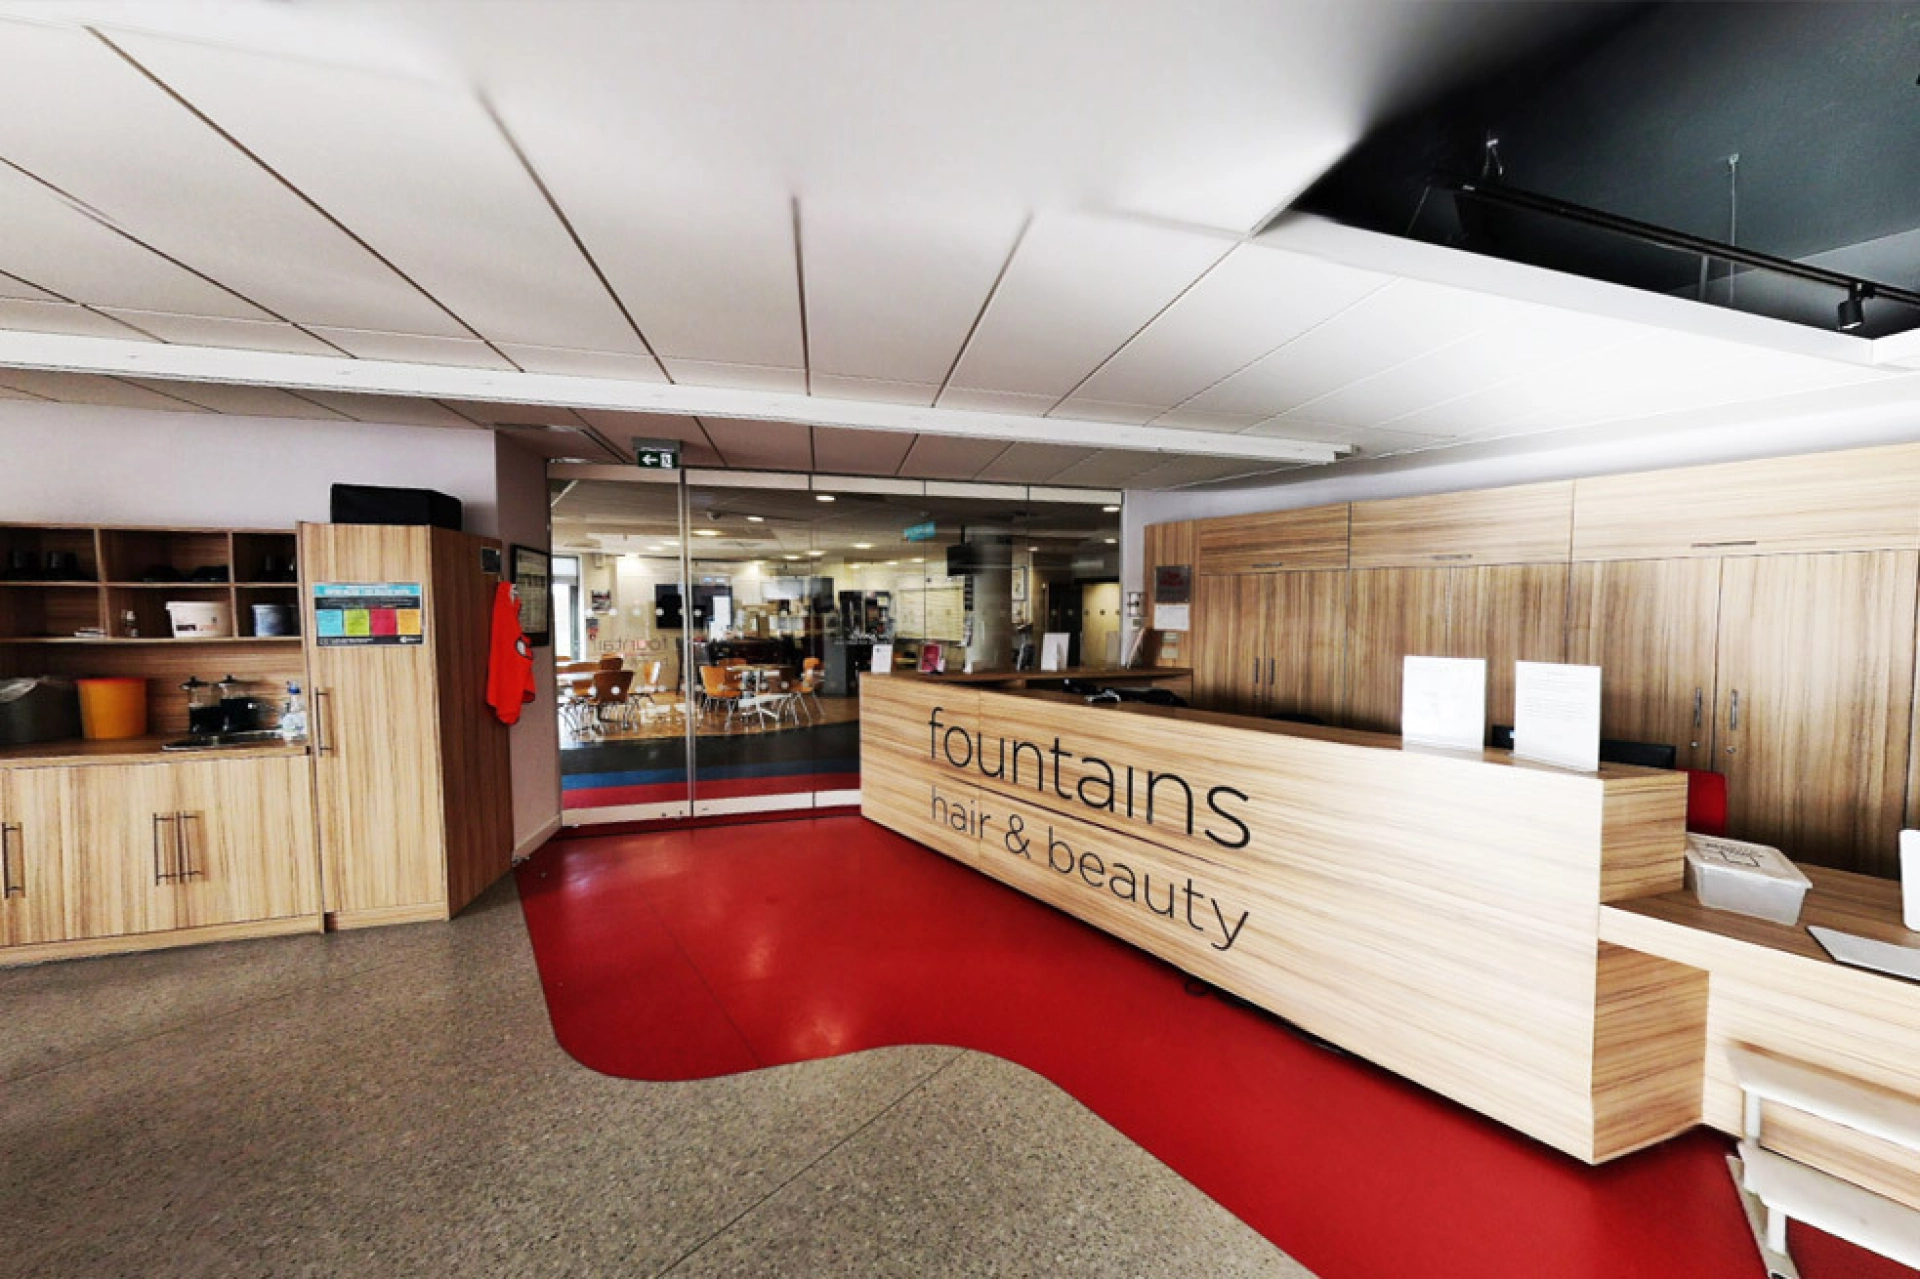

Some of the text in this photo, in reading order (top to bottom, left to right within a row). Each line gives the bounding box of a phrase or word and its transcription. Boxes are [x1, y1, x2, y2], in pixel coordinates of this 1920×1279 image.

[928, 706, 1251, 849] fountains
[930, 785, 1249, 951] hair & beauty
